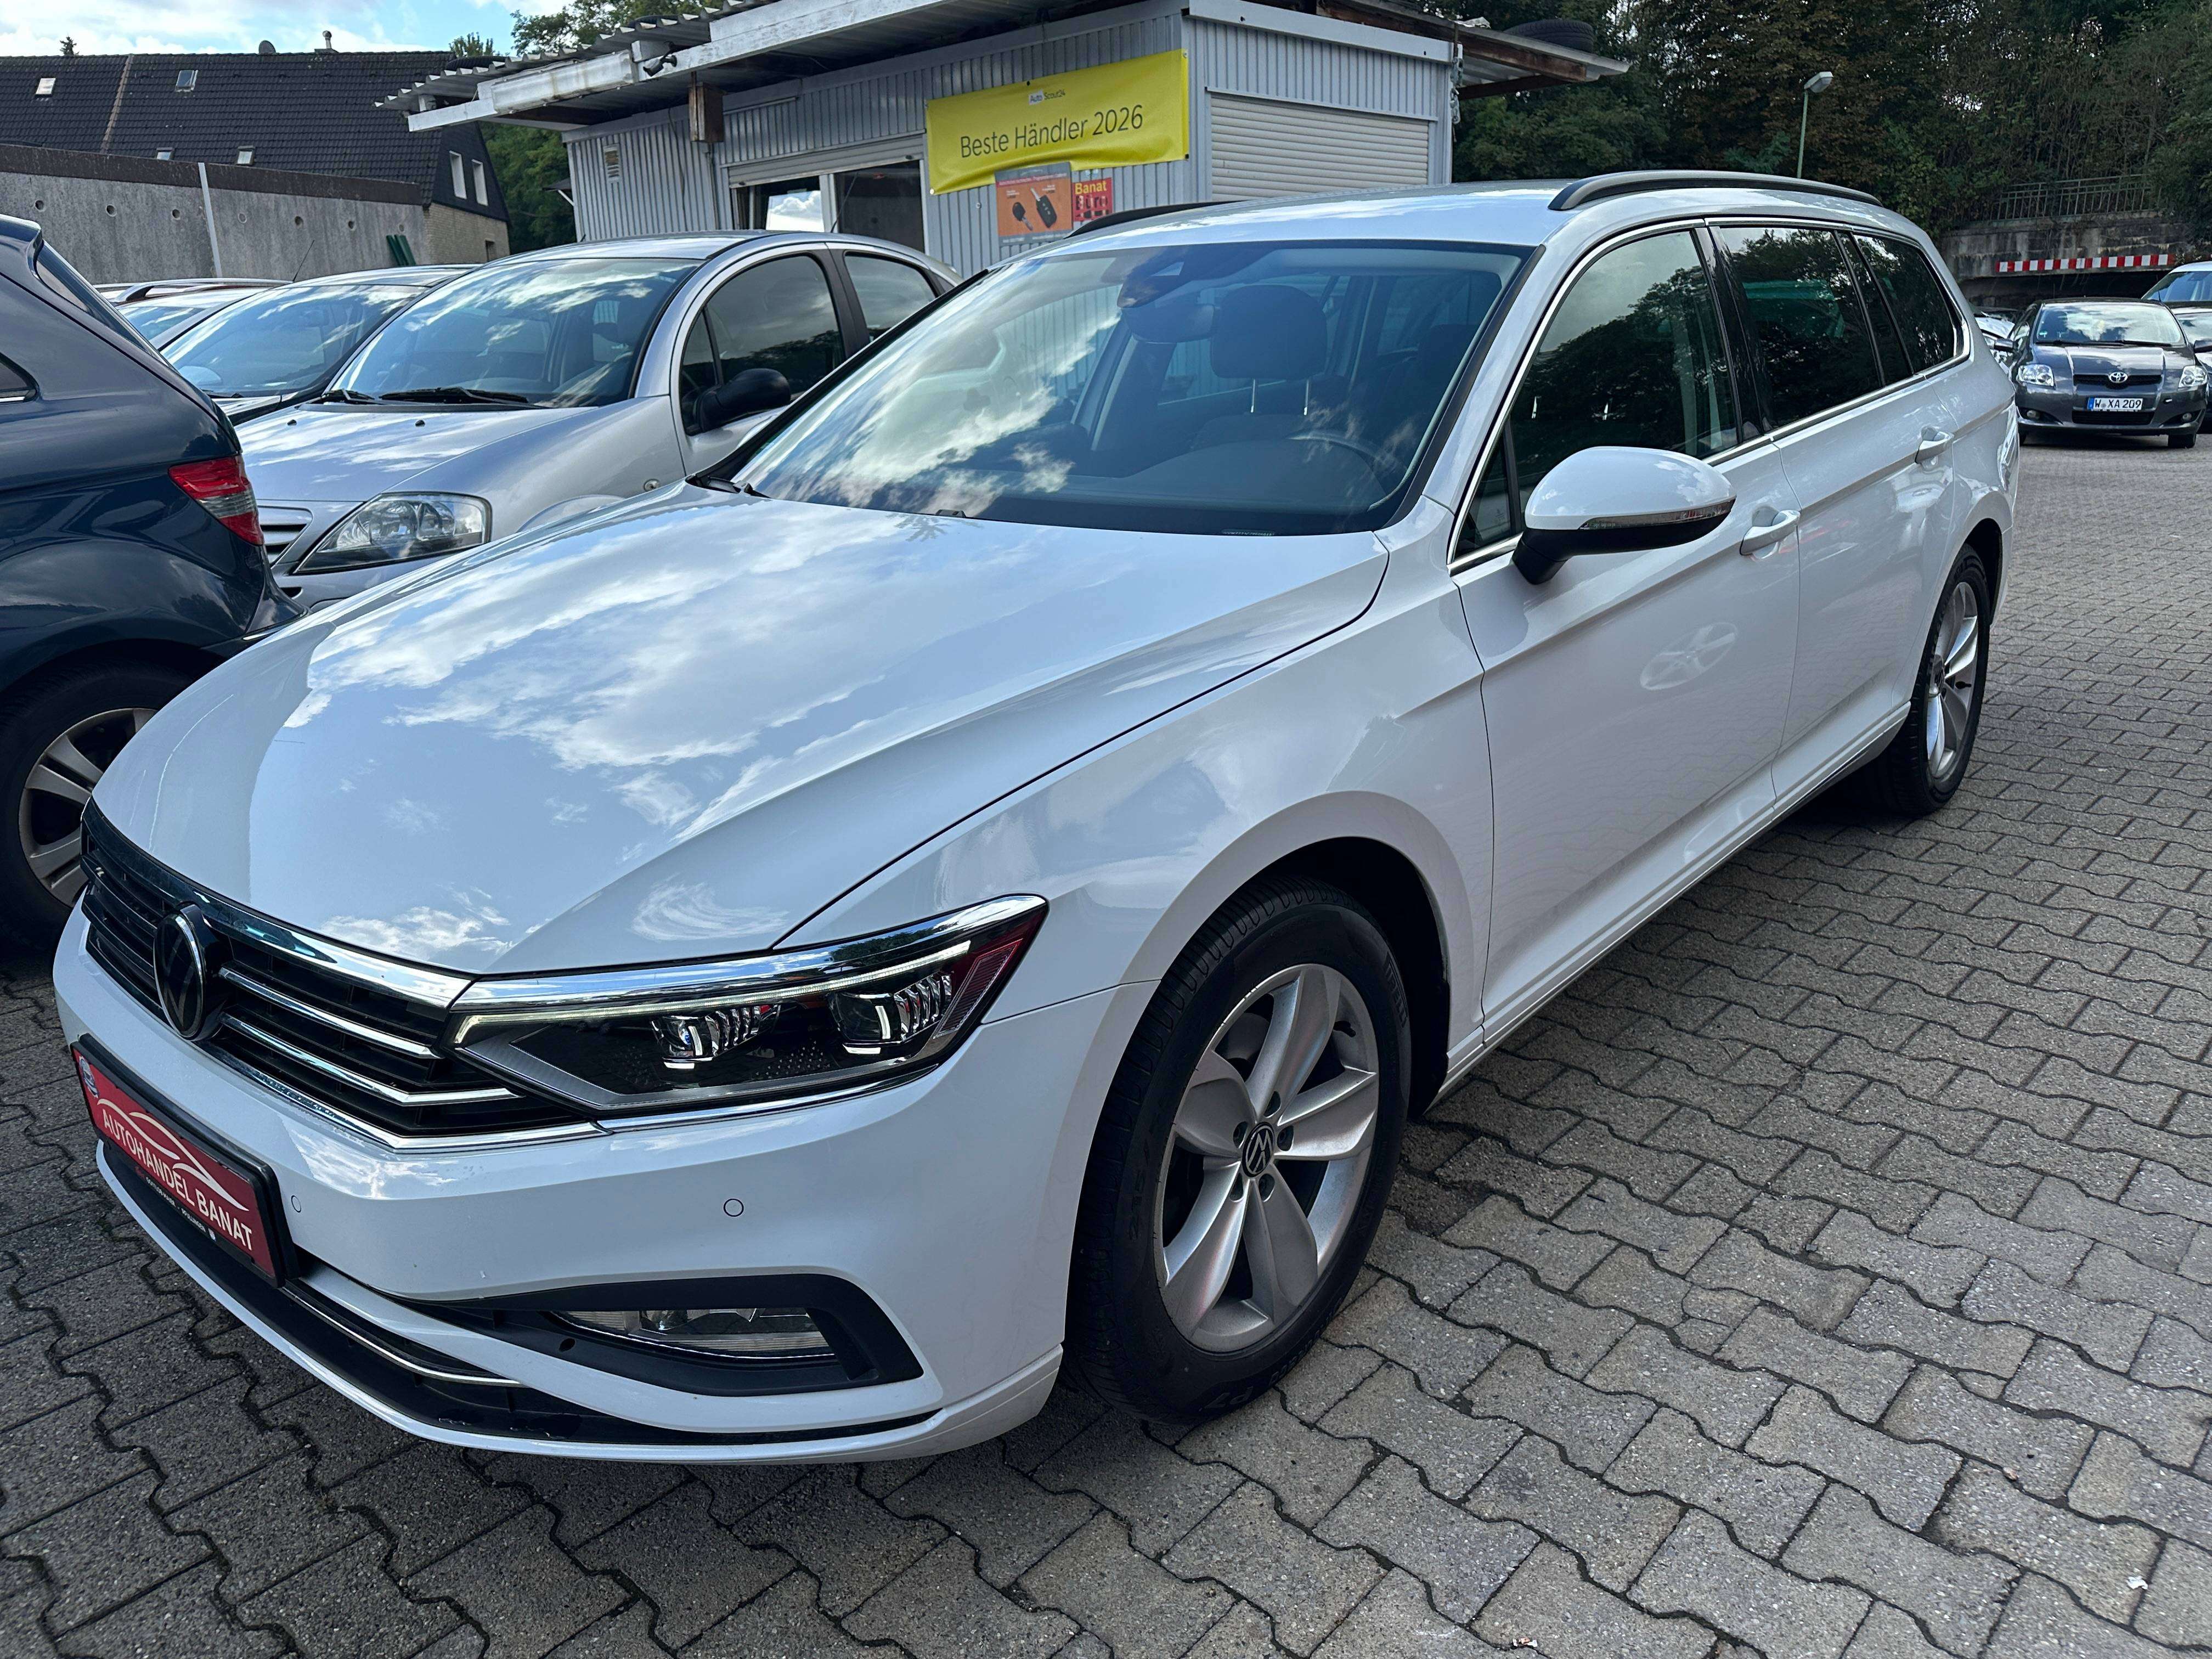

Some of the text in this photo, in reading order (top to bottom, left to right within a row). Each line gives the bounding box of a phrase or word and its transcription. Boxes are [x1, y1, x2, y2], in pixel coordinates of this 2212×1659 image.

[960, 104, 1143, 158] Beste Händler 2026
[1075, 180, 1108, 195] Banat
[2095, 399, 2142, 409] W XA 209
[102, 1109, 252, 1251] AUTOHANDEL BANAT
